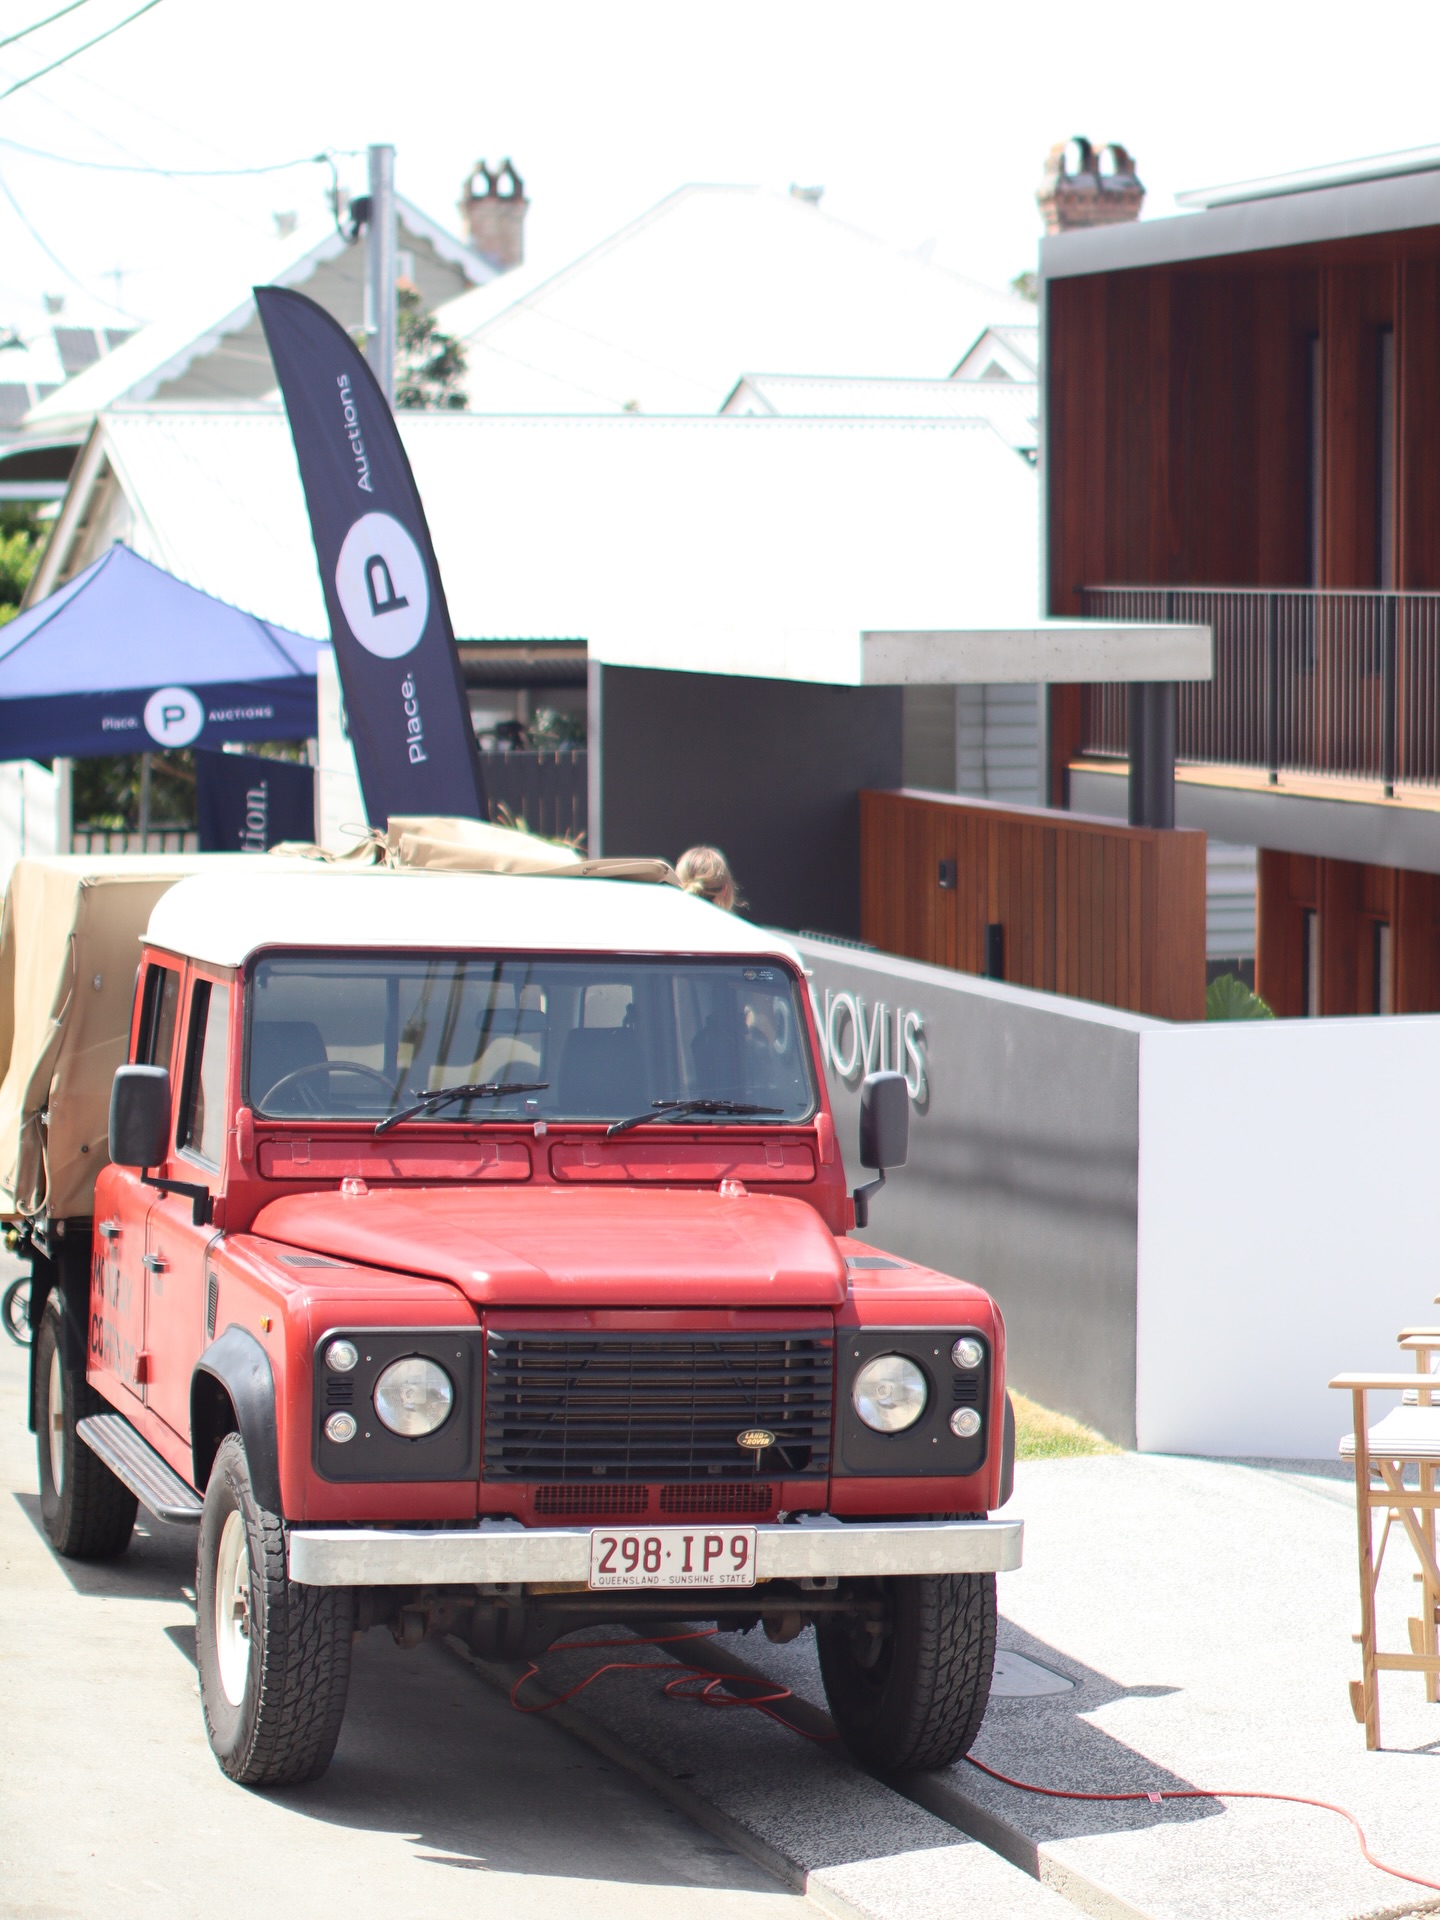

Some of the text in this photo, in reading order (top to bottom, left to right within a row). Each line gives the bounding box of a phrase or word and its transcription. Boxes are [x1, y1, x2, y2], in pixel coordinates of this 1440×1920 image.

[336, 374, 373, 493] Auctions
[363, 553, 410, 617] P
[161, 704, 186, 732] P
[208, 706, 273, 722] AUCTIONS
[401, 672, 427, 764] Place.
[807, 982, 926, 1099] NOVUS
[598, 1574, 747, 1585] QUEENSLAND SUNSHINE STATE
